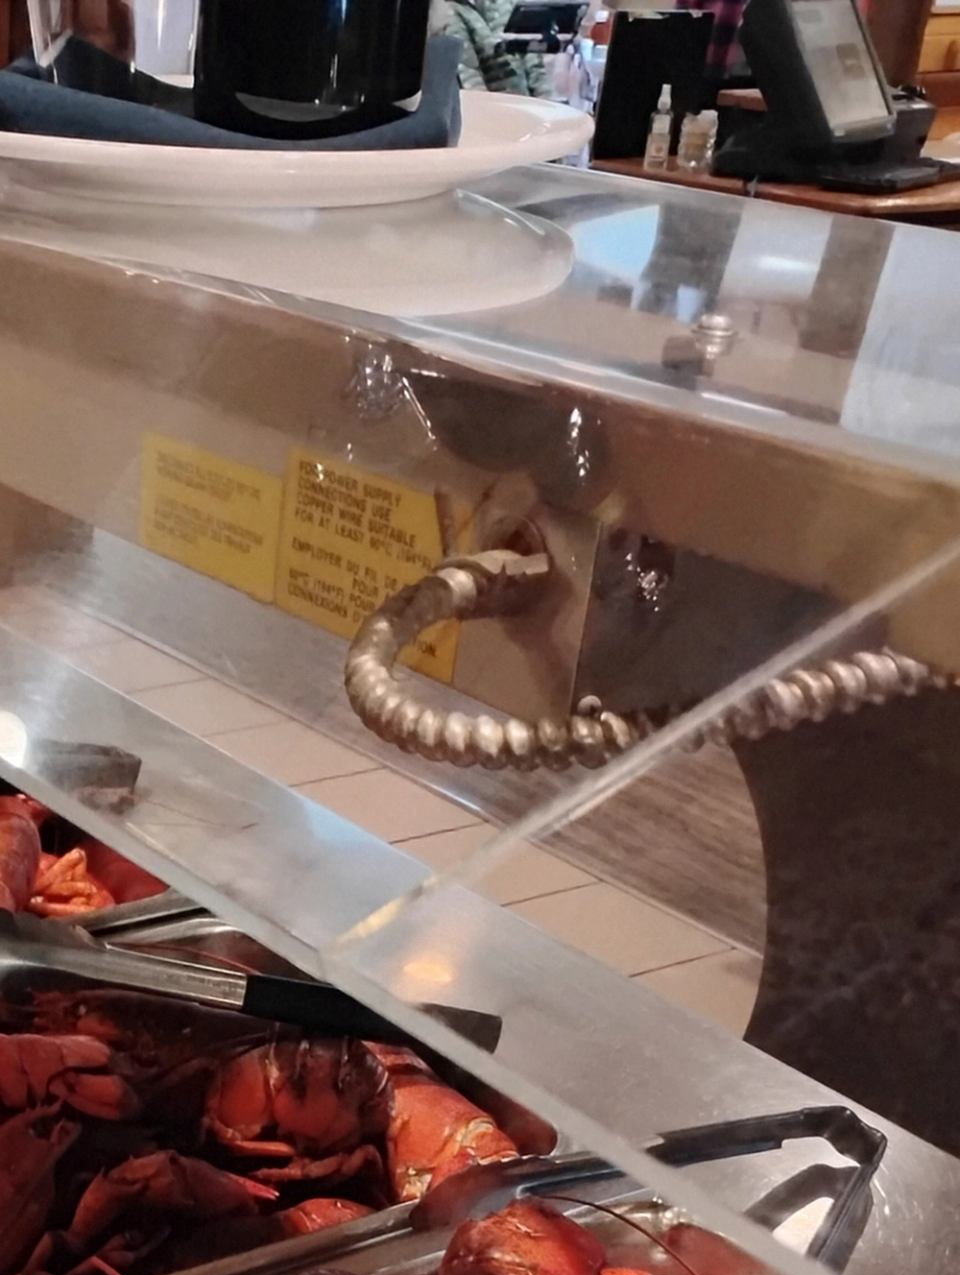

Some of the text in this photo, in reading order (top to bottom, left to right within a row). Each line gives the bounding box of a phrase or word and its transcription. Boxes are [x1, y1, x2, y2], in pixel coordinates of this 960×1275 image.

[298, 476, 392, 522] CONNECTIONS USE
[324, 468, 358, 491] POWER
[363, 483, 402, 508] SUPPLY
[295, 506, 314, 524] FOR
[318, 516, 331, 530] AT
[336, 524, 364, 545] LEAST
[297, 491, 416, 548] COPPER WIRE SUITABLE
[291, 535, 342, 568] EMPLOYER
[346, 559, 360, 576] DU
[364, 565, 378, 583] FIL
[288, 581, 348, 619] CONNEXIONS
[349, 592, 376, 613] POUR
[352, 577, 378, 598] POUR
